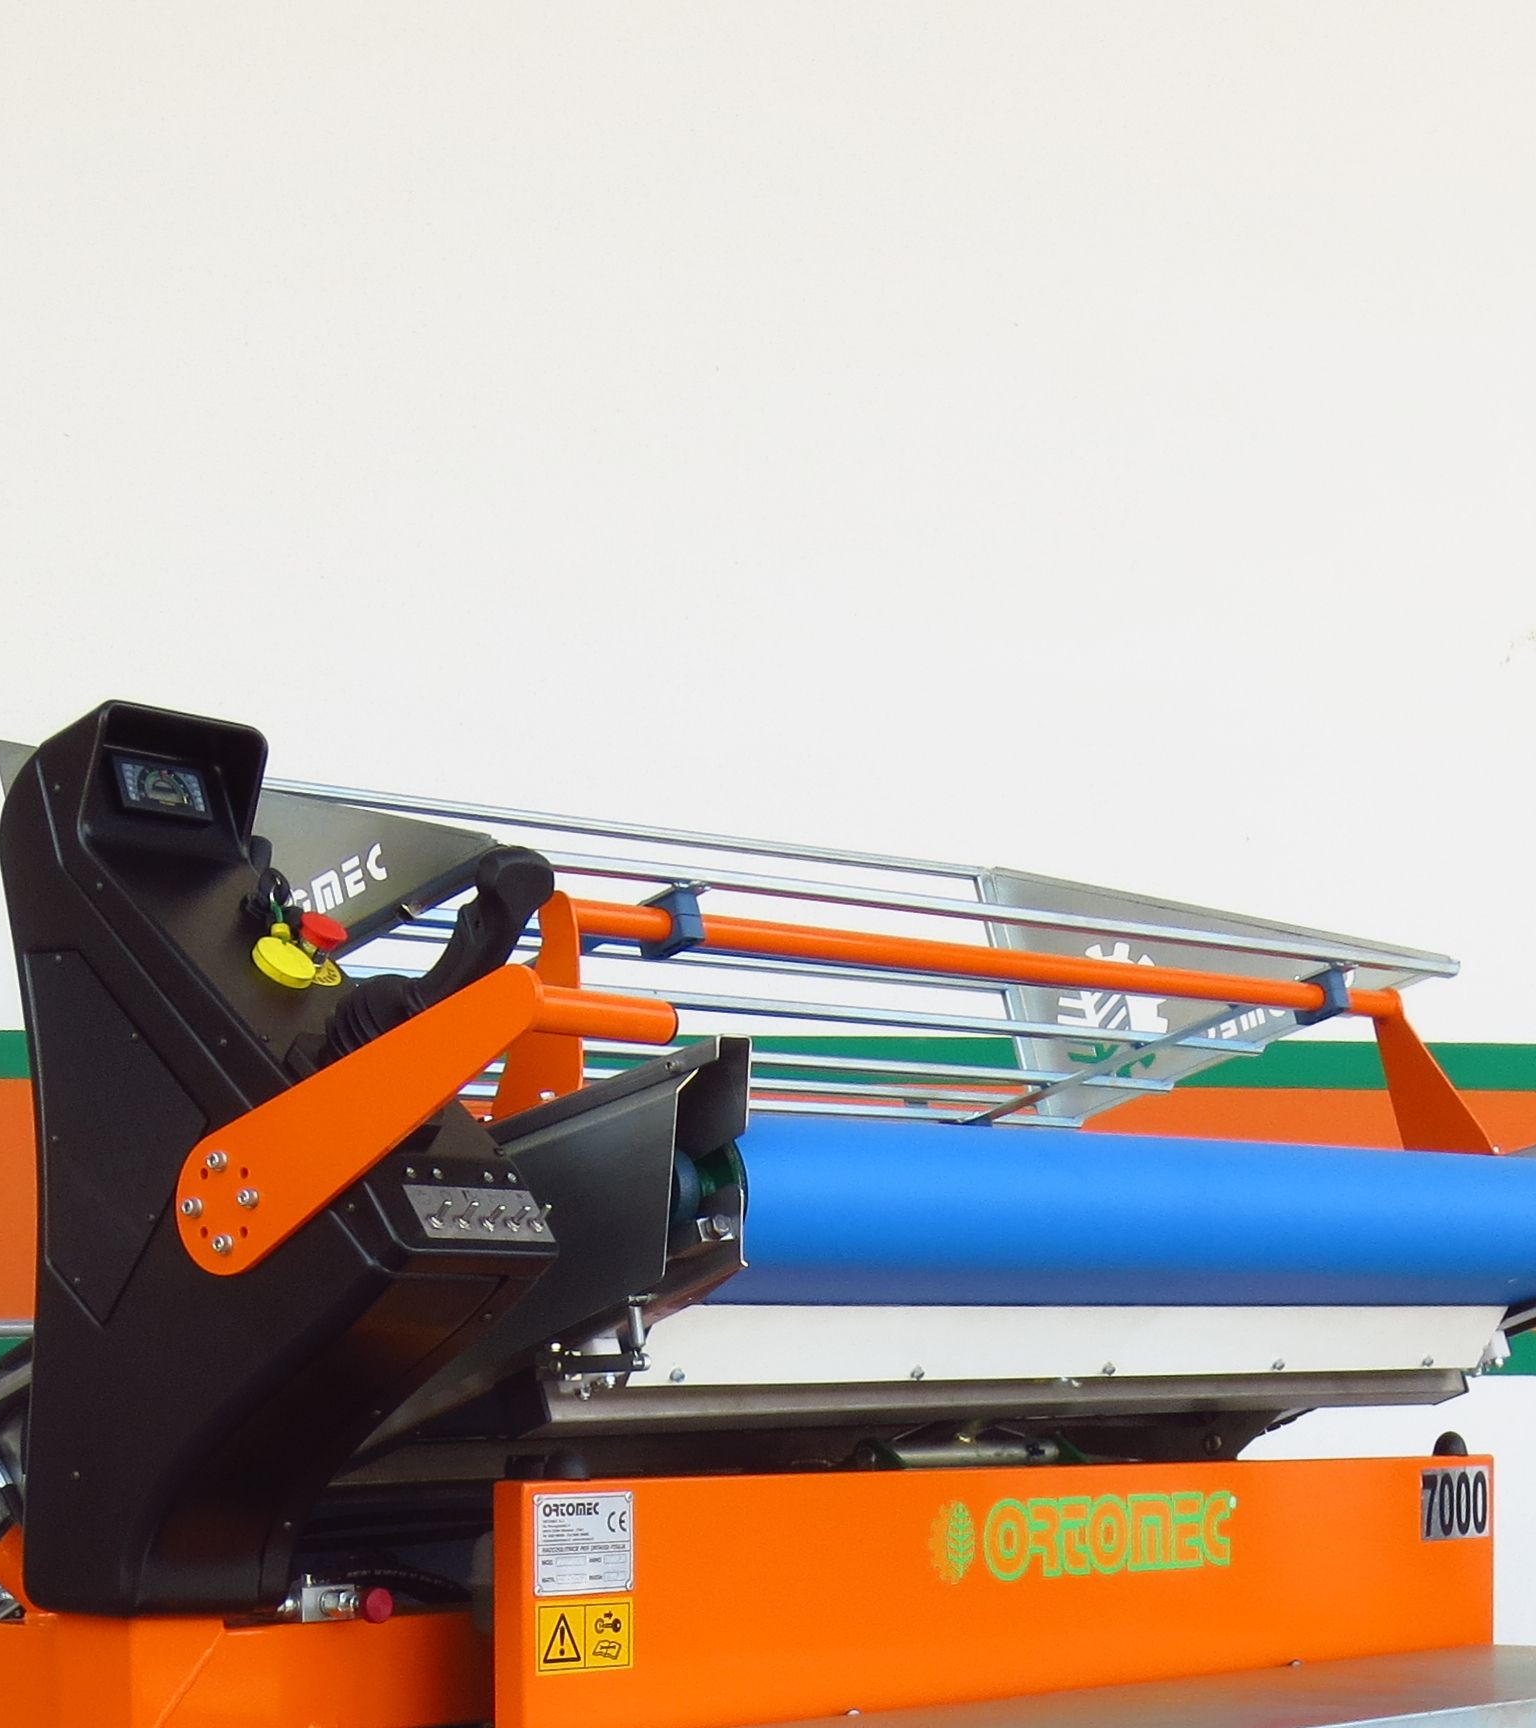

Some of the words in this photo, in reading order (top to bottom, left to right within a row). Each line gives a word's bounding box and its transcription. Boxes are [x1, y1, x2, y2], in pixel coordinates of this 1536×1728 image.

[542, 1502, 600, 1517] ORTOMEC
[983, 1490, 1231, 1582] ORTOMEC
[1421, 1470, 1487, 1537] 7000
